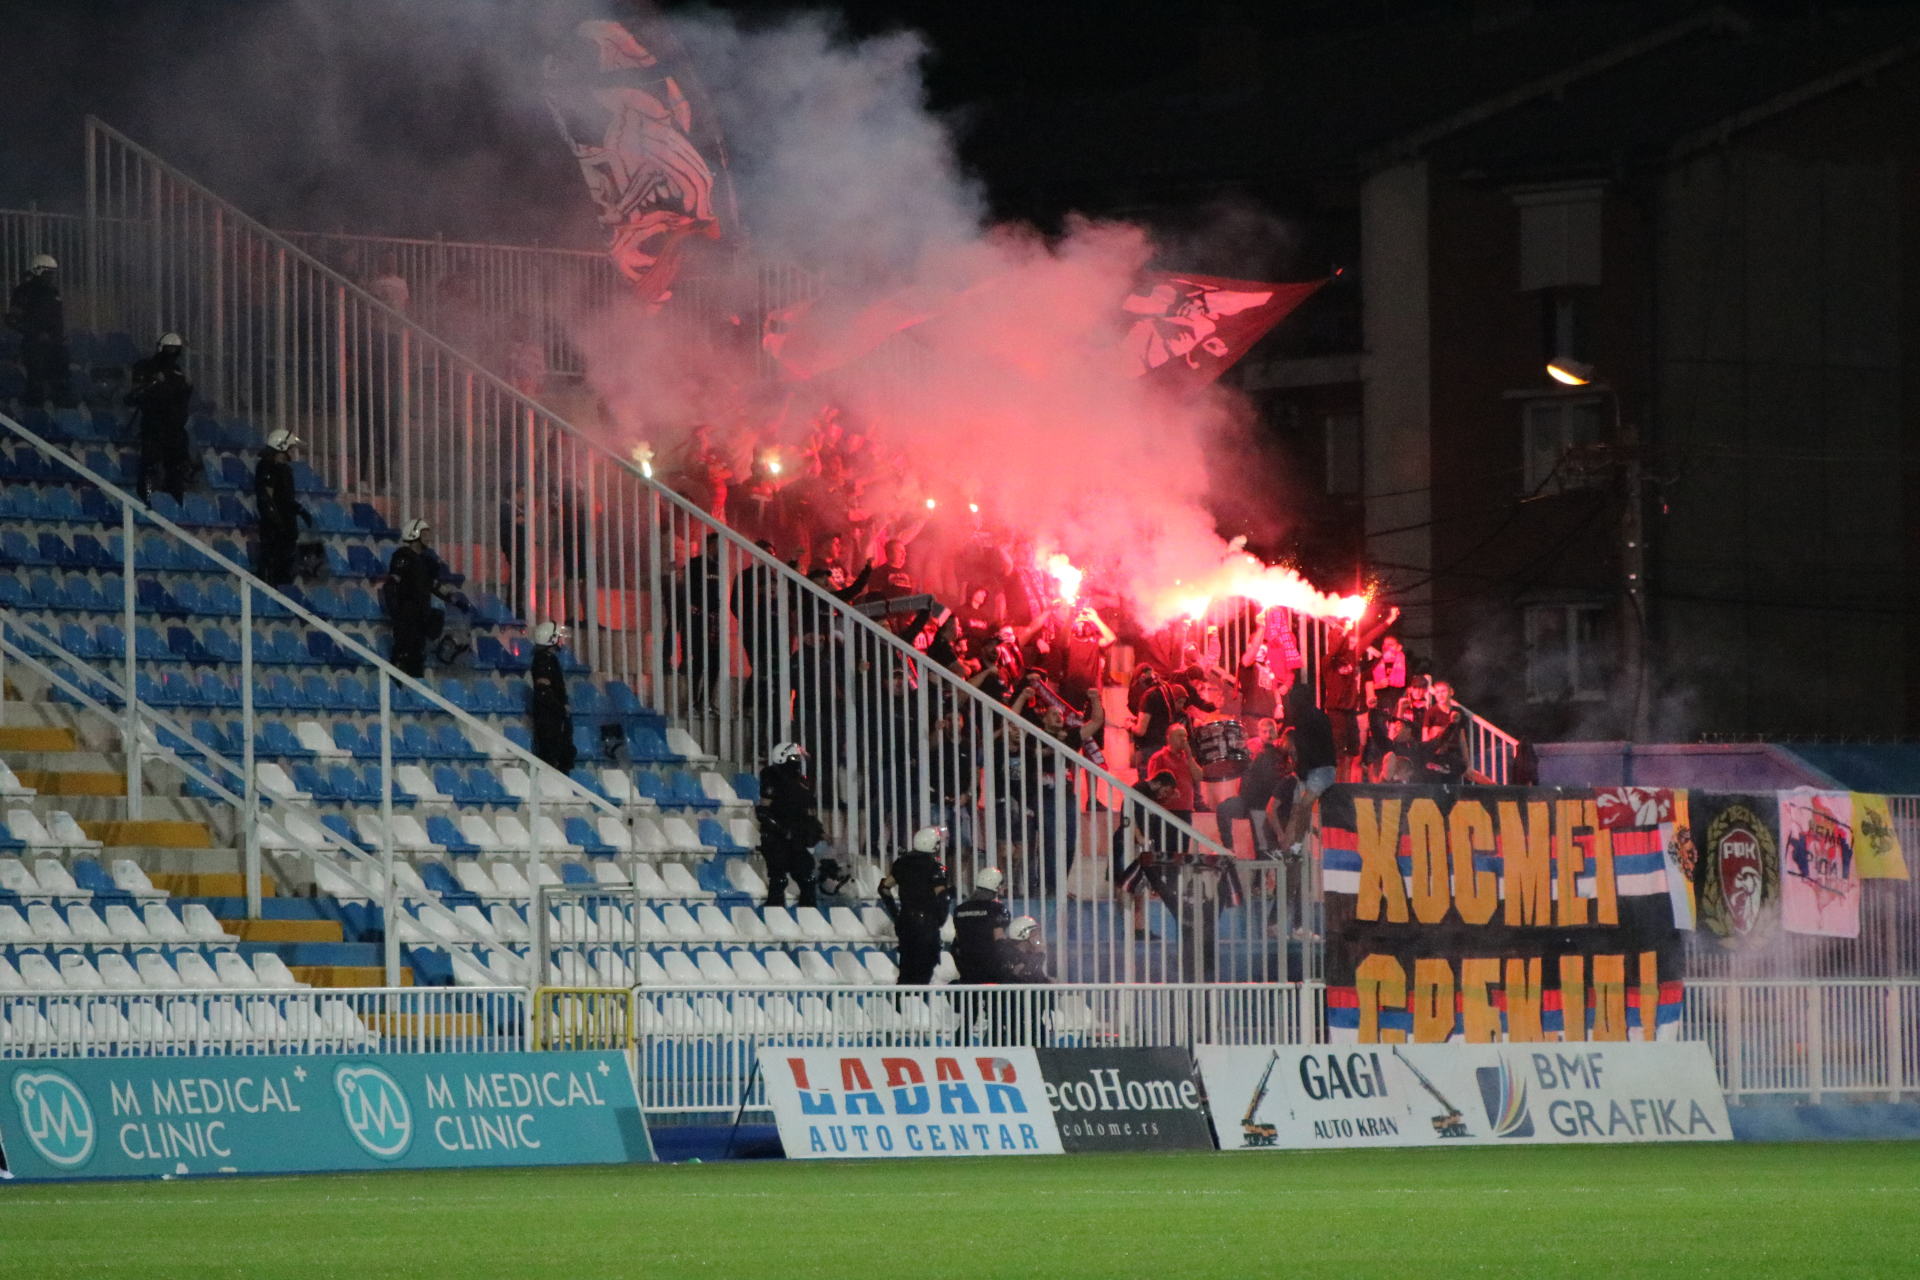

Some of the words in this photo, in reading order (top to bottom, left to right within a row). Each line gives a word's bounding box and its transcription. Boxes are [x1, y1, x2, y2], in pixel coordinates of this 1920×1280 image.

[426, 1075, 455, 1109] M
[465, 1073, 605, 1108] MEDICAL
[788, 1057, 1027, 1115] LADAR
[1044, 1069, 1199, 1111] ecoHome
[1299, 1053, 1387, 1100] GAGI
[1533, 1053, 1603, 1090] BMF
[111, 1080, 141, 1116] M
[154, 1076, 300, 1115] MEDICAL
[435, 1114, 541, 1151] CLINIC
[810, 1124, 894, 1153] AUTO
[907, 1122, 1039, 1152] CENTAR
[1314, 1118, 1353, 1140] AUTO
[1356, 1117, 1399, 1138] KRAN
[1548, 1099, 1717, 1138] GRAFIKA
[119, 1121, 231, 1160] CLINIC
